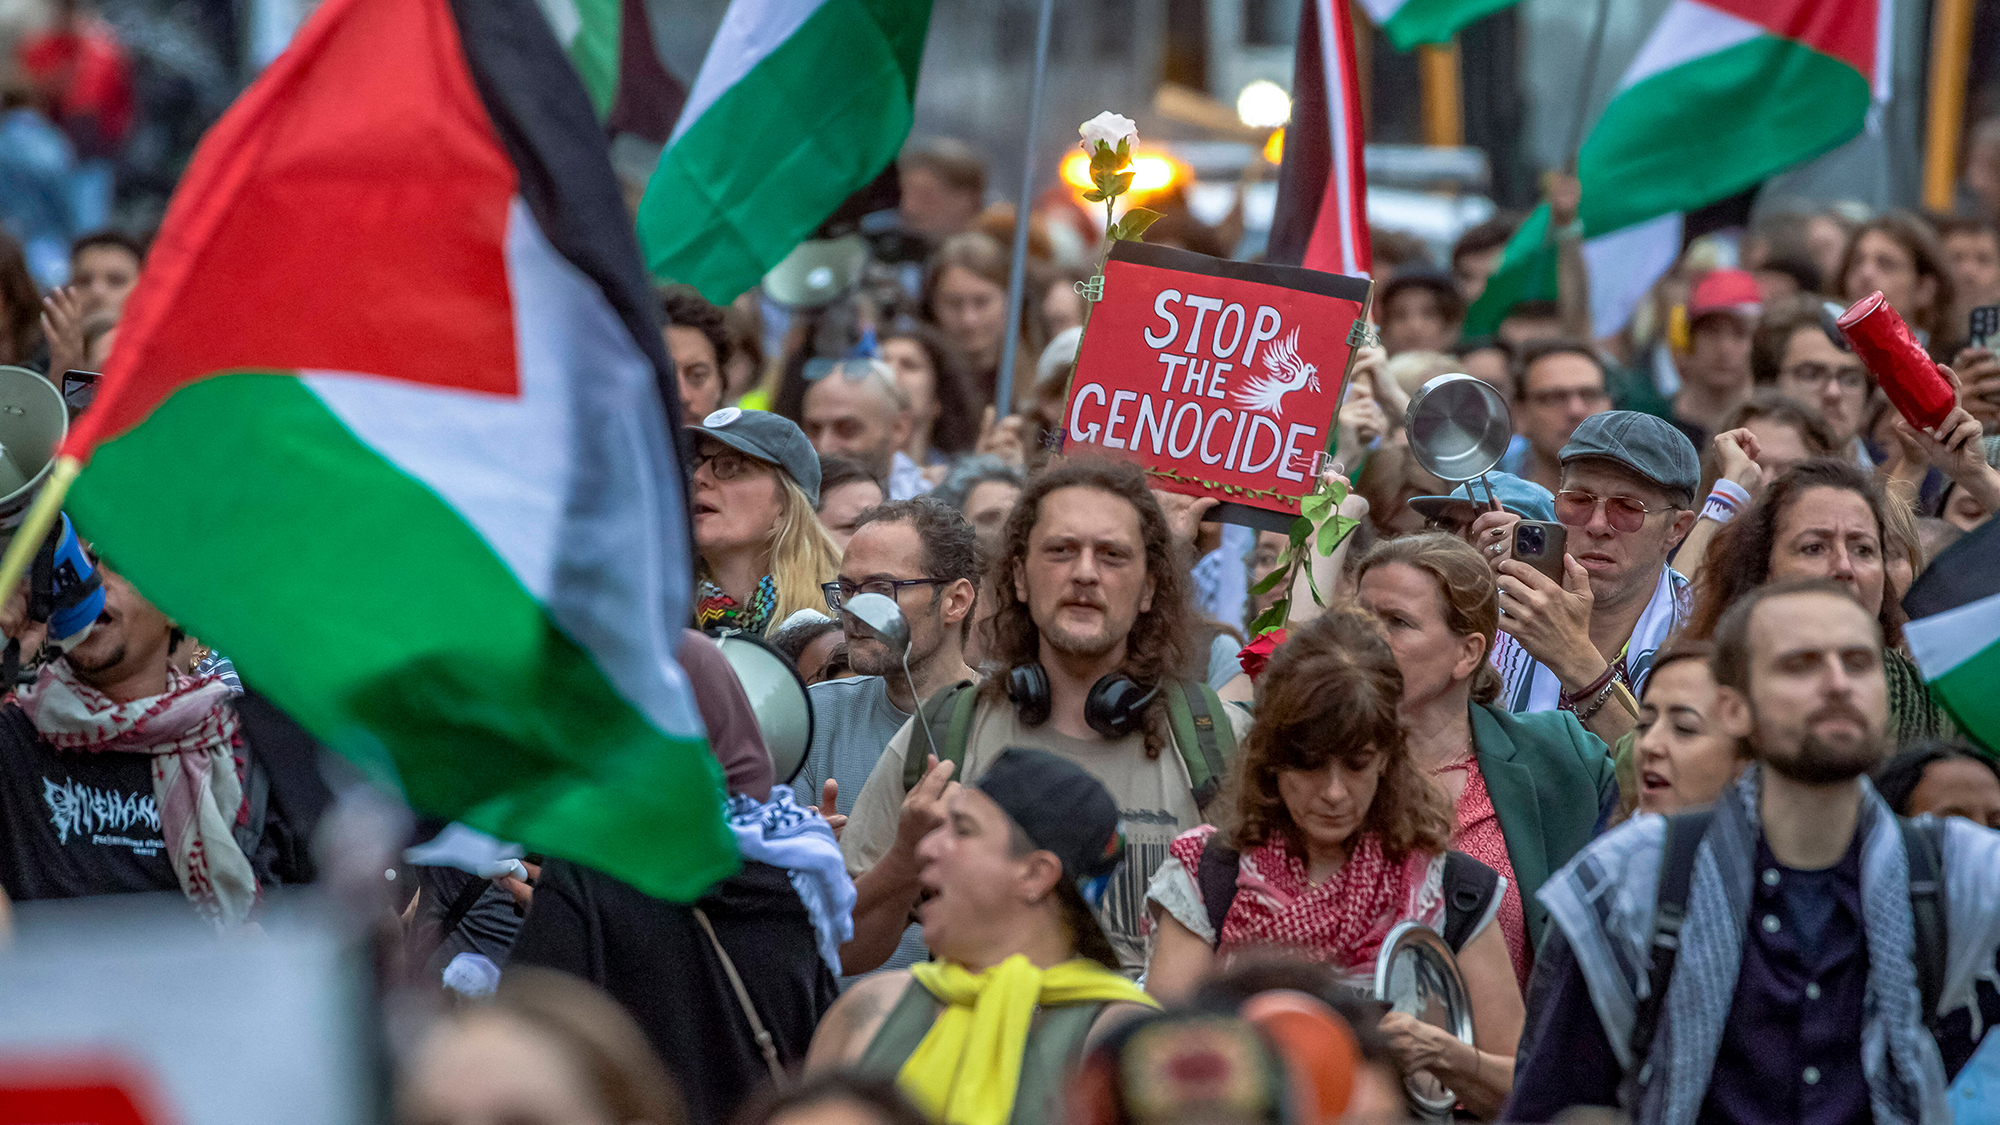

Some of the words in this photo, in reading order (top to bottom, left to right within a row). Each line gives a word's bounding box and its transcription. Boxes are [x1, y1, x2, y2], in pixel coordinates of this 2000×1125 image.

[1144, 289, 1282, 368] STOP
[1158, 353, 1233, 399] THE
[1069, 382, 1317, 482] GENOCIDE
